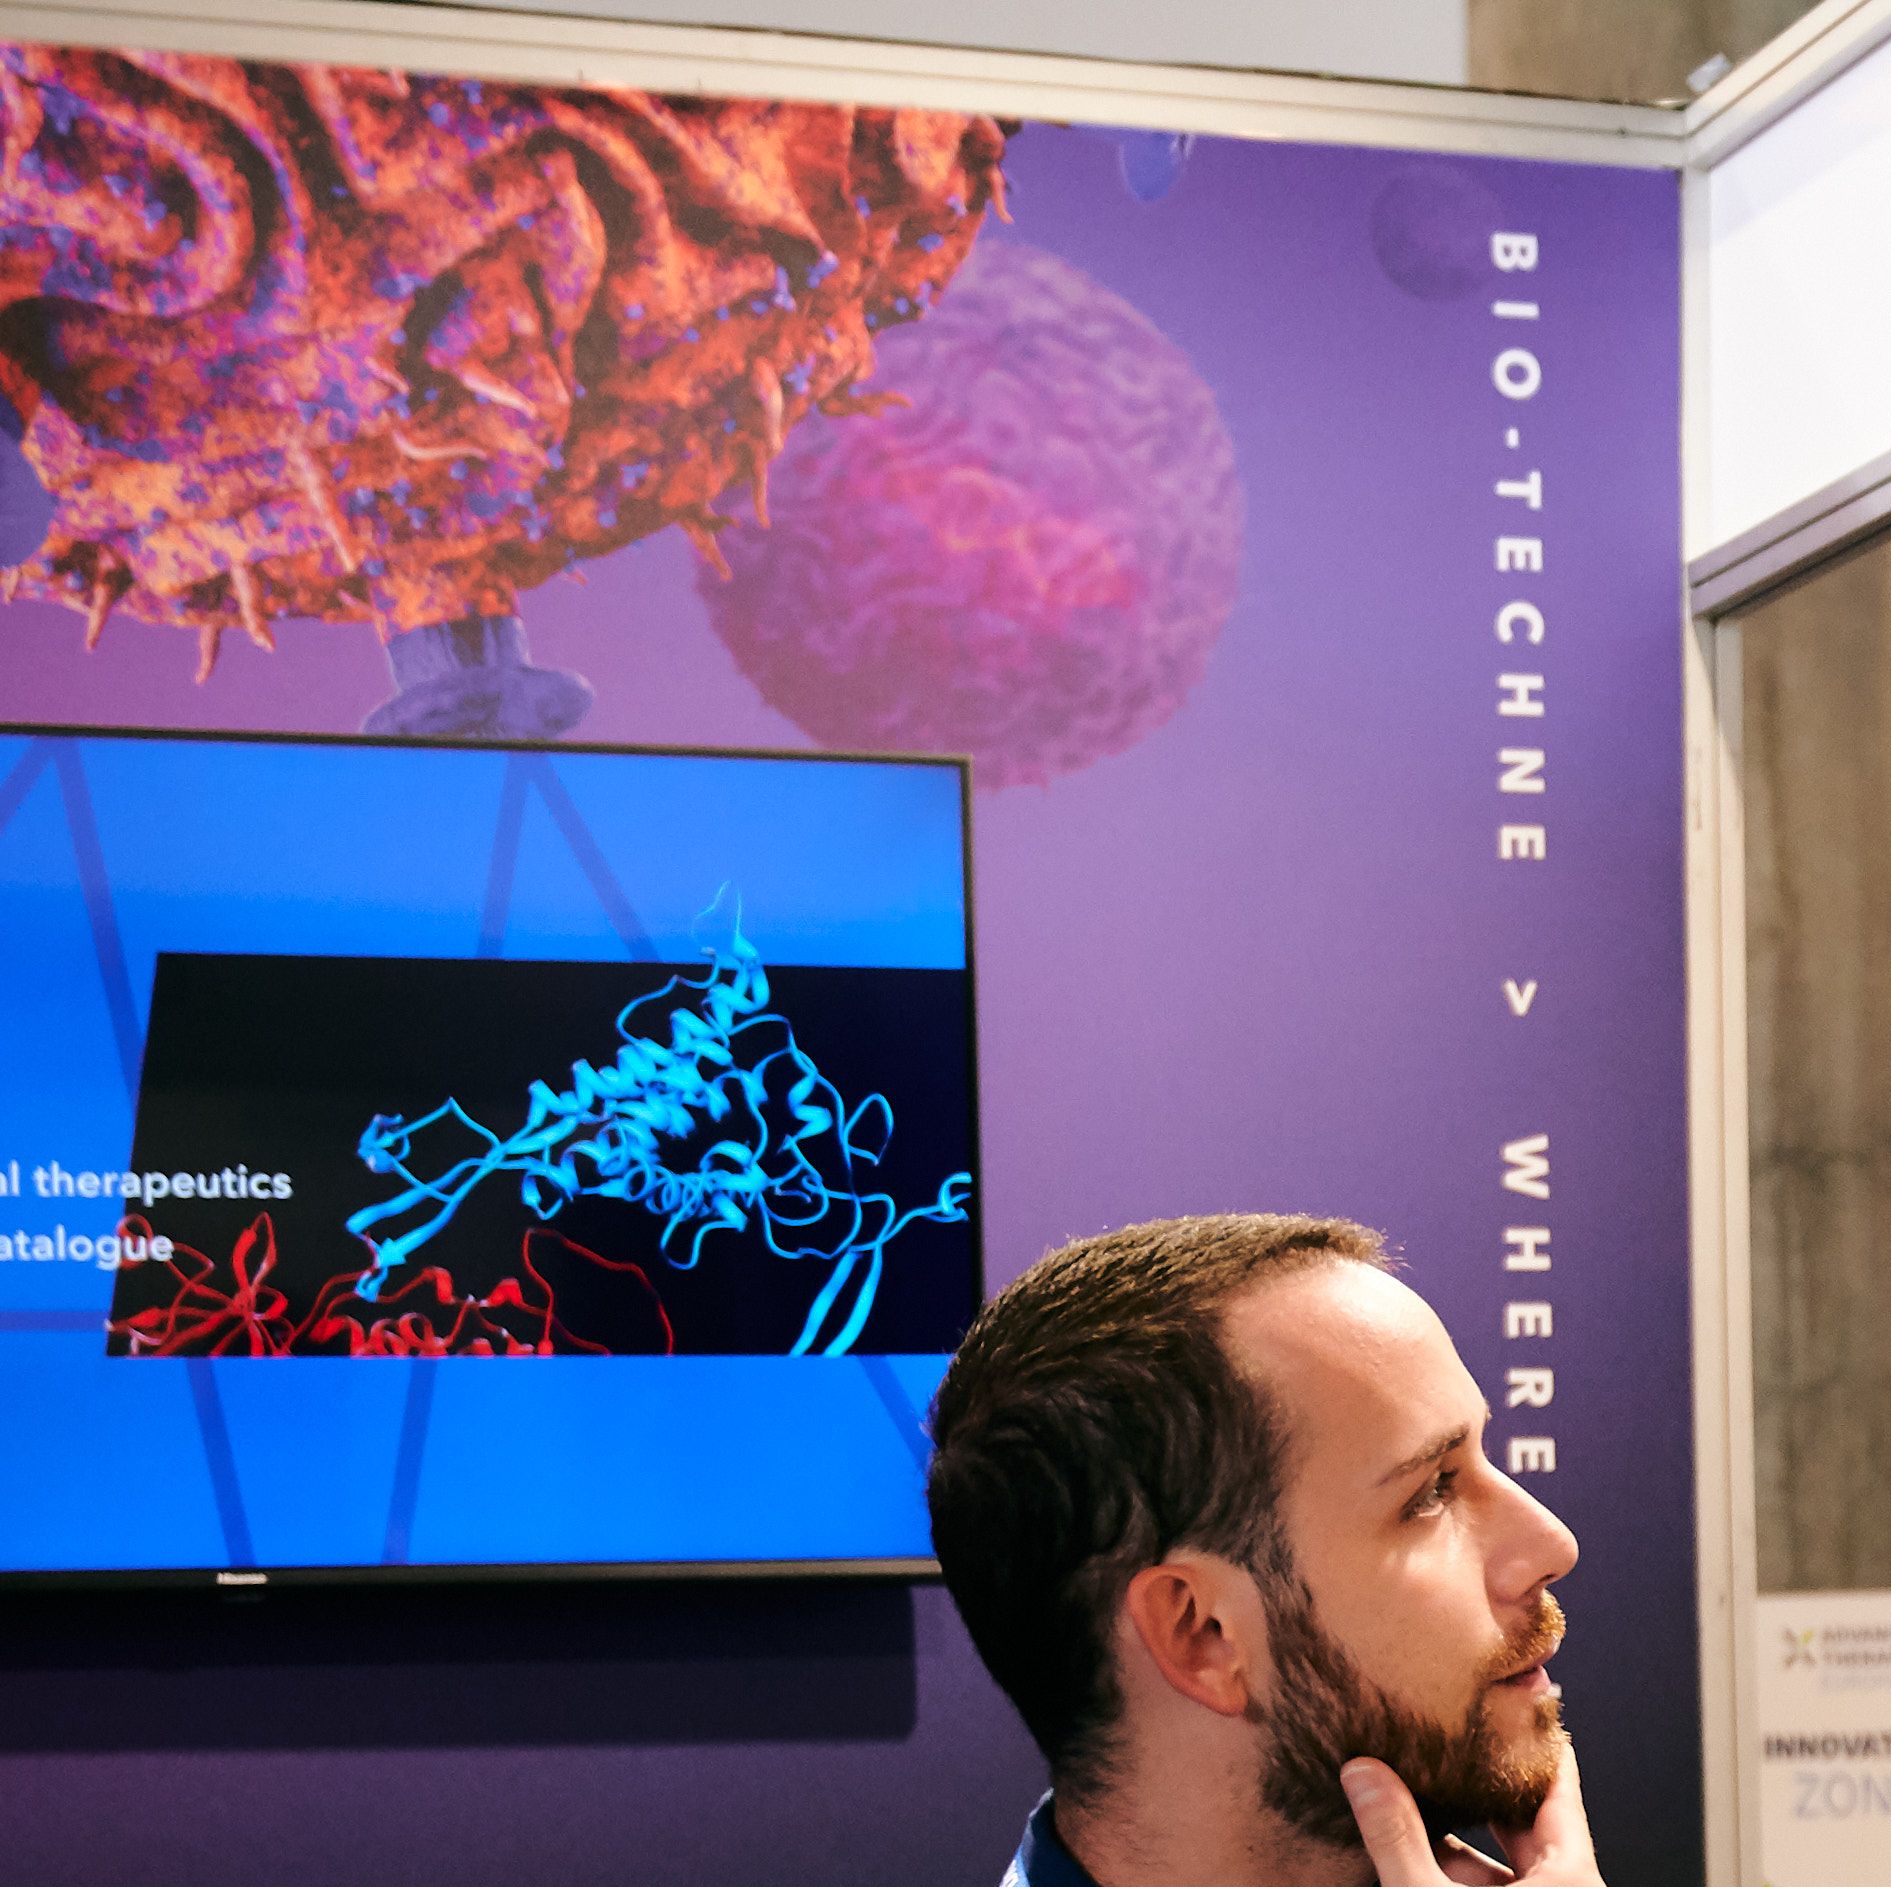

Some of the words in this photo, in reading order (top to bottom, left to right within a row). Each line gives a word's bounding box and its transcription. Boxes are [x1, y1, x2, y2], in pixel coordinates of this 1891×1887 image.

[1492, 232, 1548, 861] BIO-TECHNE
[33, 1160, 294, 1208] therapeutics
[1502, 1132, 1558, 1475] WHERE
